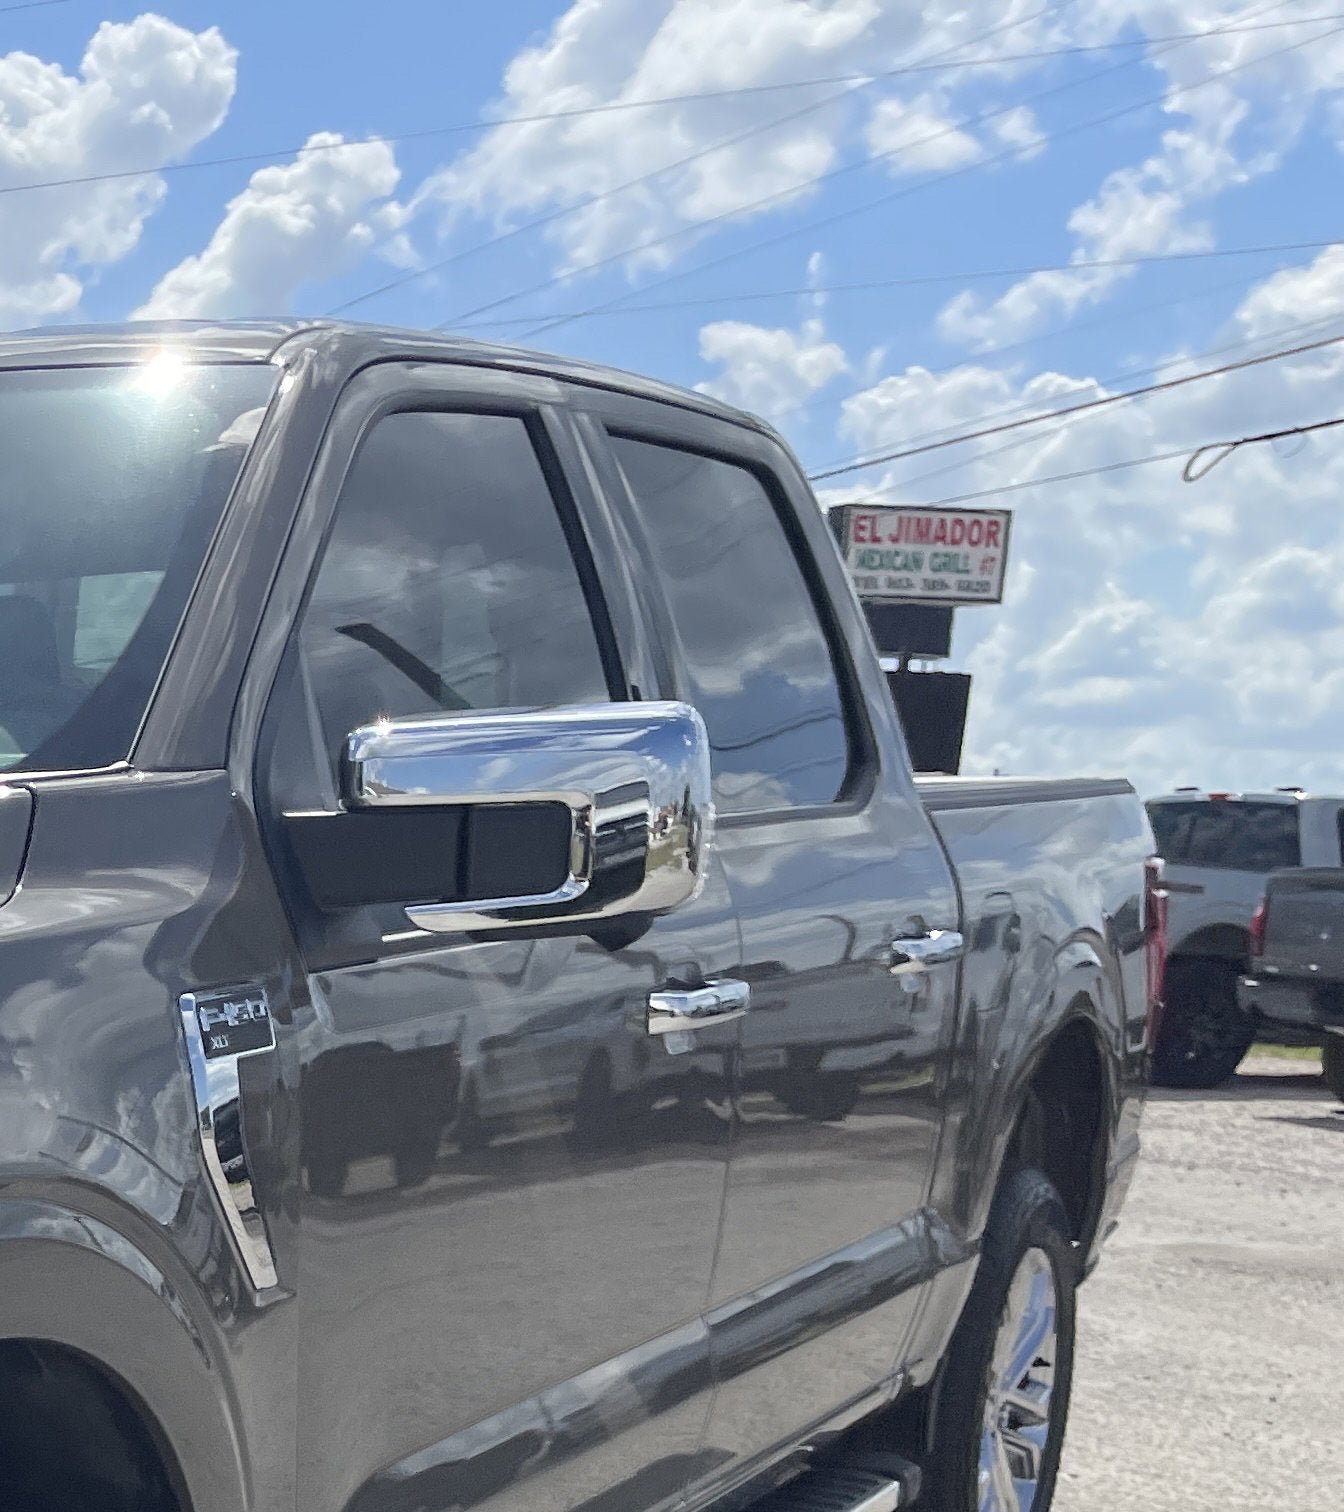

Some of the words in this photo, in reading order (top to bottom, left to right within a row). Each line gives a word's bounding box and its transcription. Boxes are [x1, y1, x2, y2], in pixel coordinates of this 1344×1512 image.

[853, 515, 882, 544] EL
[888, 515, 1001, 548] JIMADOR
[210, 1033, 229, 1050] XLT
